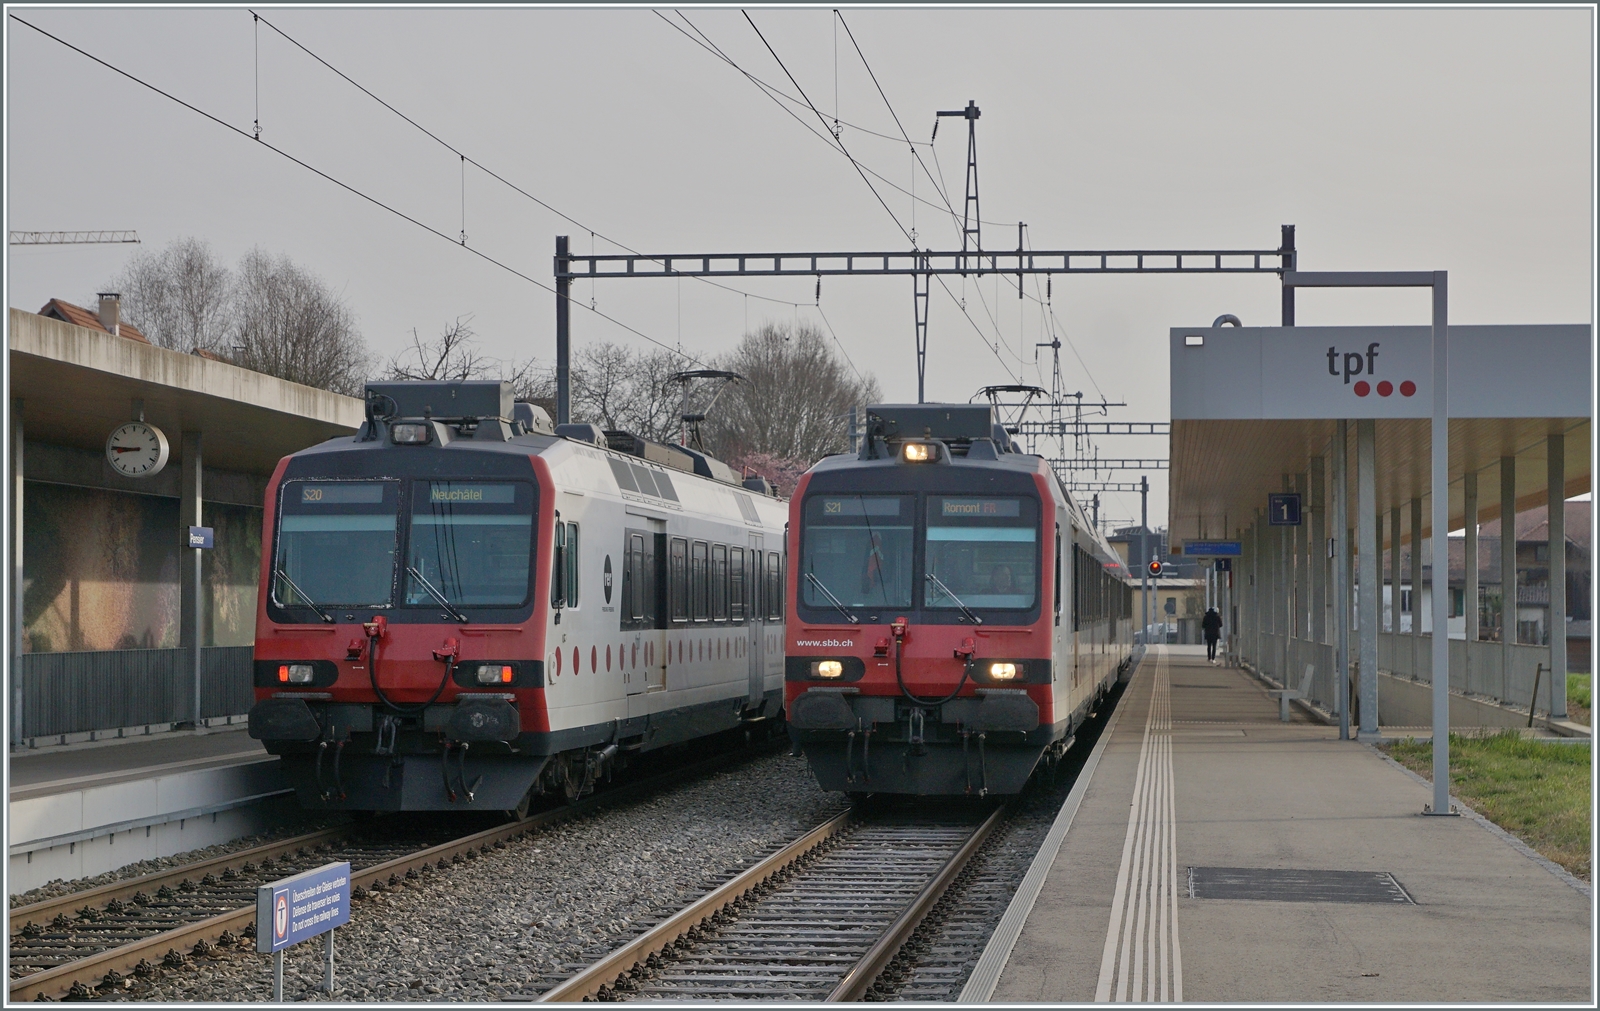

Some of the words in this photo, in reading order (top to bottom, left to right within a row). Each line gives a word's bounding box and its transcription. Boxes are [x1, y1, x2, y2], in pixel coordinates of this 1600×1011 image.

[1326, 342, 1380, 385] tpf
[303, 489, 322, 501] S20
[432, 489, 482, 501] Neuchâtel
[825, 502, 841, 513] S21
[944, 502, 980, 513] Romont
[983, 502, 996, 513] FR
[1281, 504, 1288, 520] 1
[1220, 560, 1225, 568] 1
[796, 639, 853, 647] www.sbb.ch
[293, 886, 316, 902] Überschreiten
[322, 880, 332, 892] Gleise
[332, 876, 346, 888] verboten
[306, 902, 312, 912] de
[312, 898, 326, 910] traverser
[332, 892, 340, 902] voies
[292, 922, 298, 932] Do
[304, 916, 314, 928] cross
[320, 910, 330, 922] railway
[330, 906, 339, 917] lines
